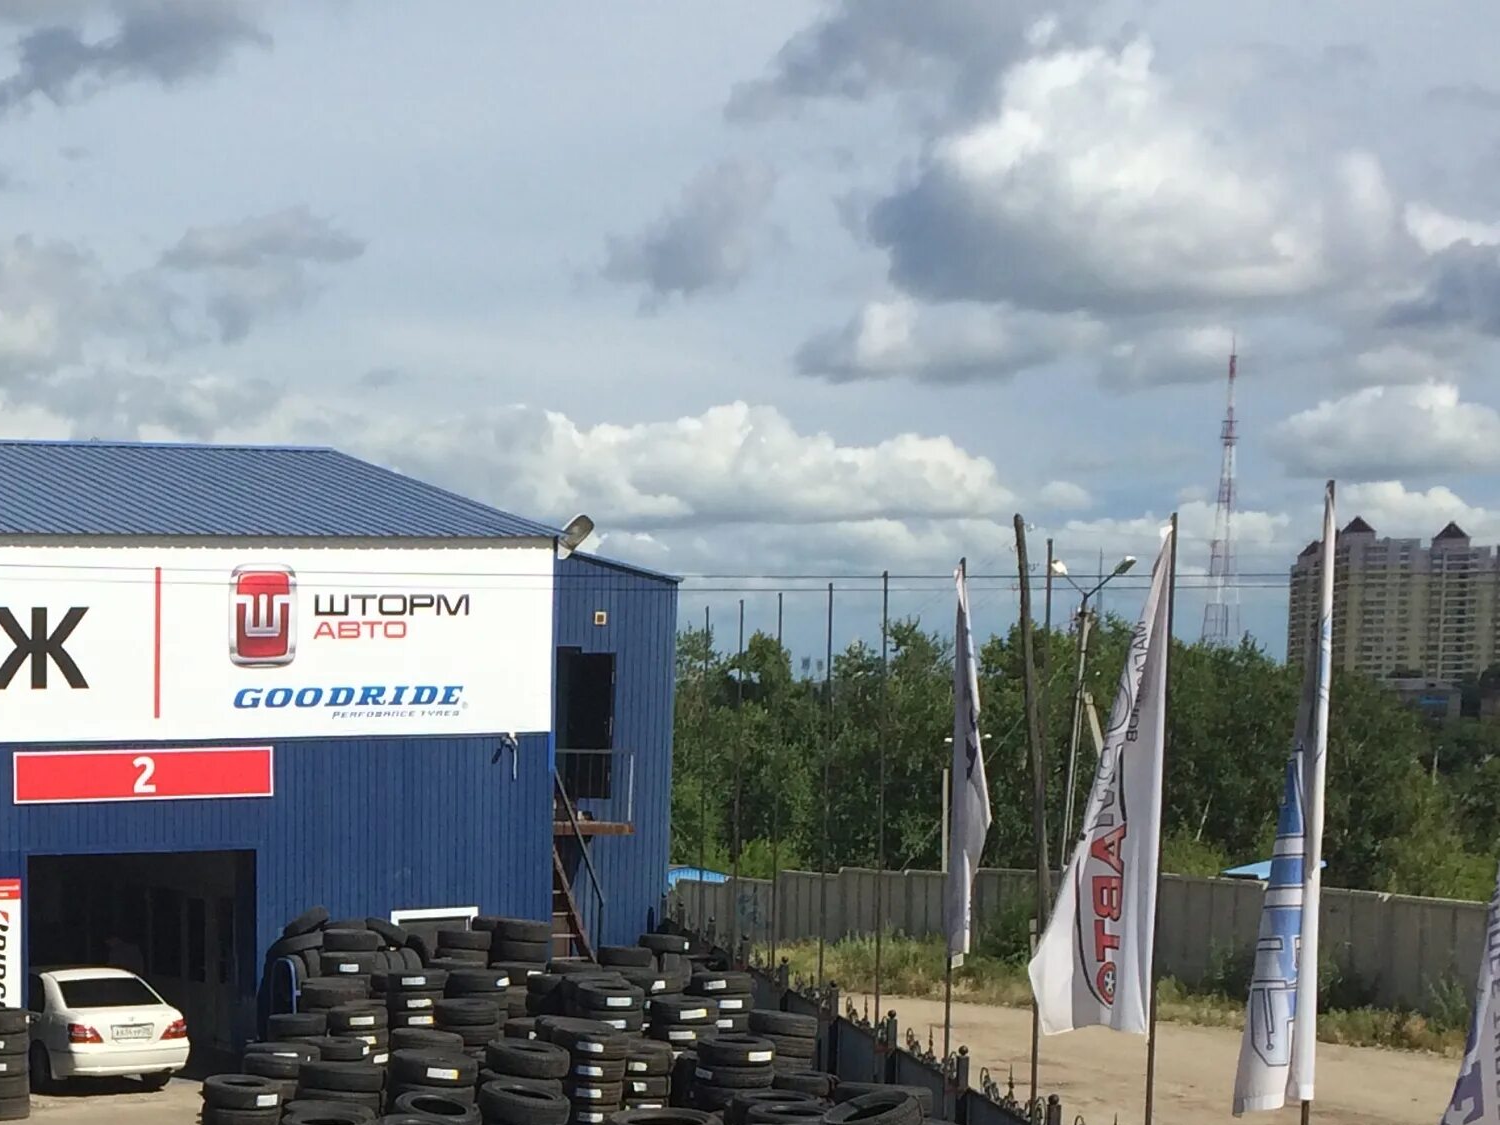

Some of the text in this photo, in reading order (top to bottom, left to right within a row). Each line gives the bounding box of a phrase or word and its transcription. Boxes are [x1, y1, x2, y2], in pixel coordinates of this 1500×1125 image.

[314, 594, 470, 616] ШТОРМ
[313, 621, 408, 639] АВТО
[233, 685, 464, 709] GOODRIDE
[132, 757, 157, 793] 2
